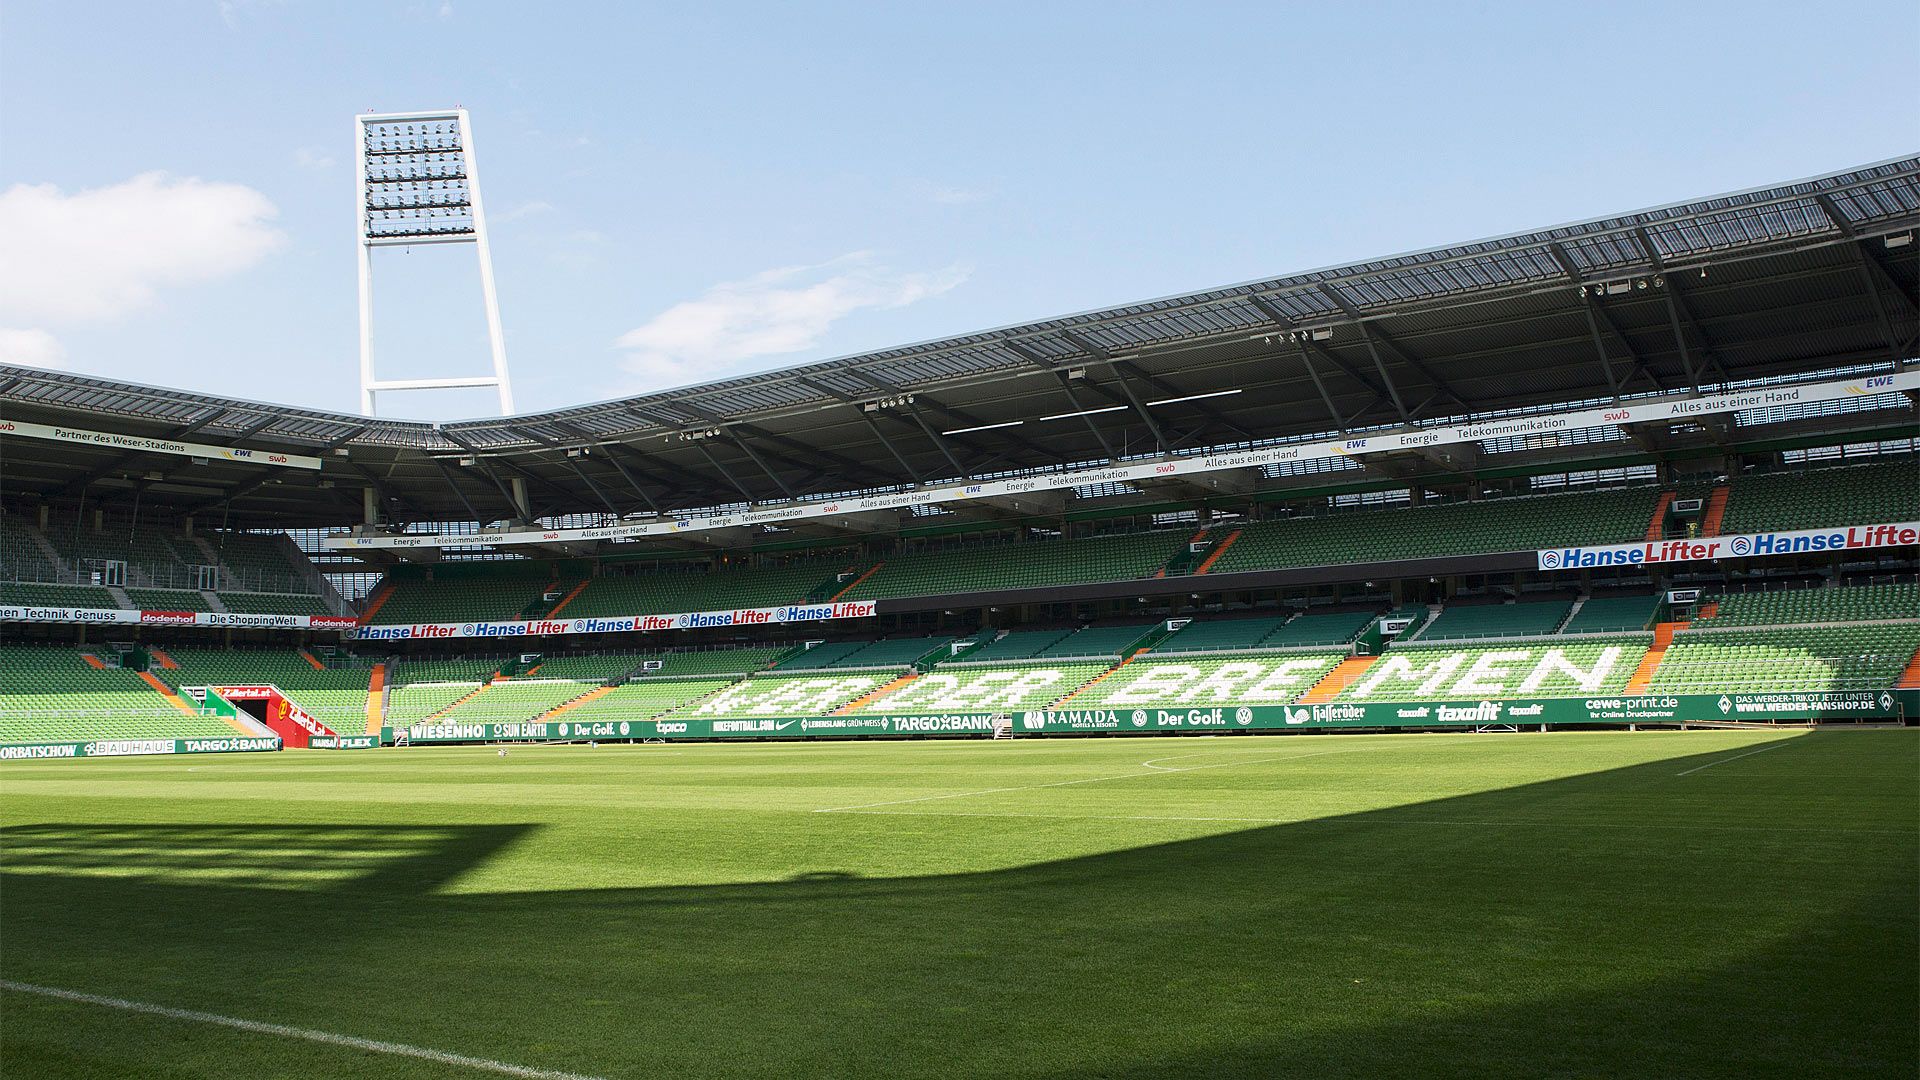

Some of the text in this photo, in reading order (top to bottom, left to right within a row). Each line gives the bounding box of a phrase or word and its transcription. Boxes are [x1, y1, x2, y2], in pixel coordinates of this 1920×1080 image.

[1866, 375, 1894, 389] EWE
[1670, 388, 1799, 414] Alles aus einer Hand
[1604, 409, 1630, 421] swb
[0, 422, 15, 431] wb
[1400, 418, 1566, 447] Energie Telekommunikation
[55, 429, 185, 452] Partner des Weser-Stadions
[1346, 439, 1367, 449] EWE
[269, 455, 287, 463] swb
[1205, 449, 1298, 468] Alles aus einer Hand
[1156, 463, 1175, 473] swb
[1006, 470, 1128, 492] Energie Telekommunikation
[860, 500, 878, 508] Alles
[892, 496, 910, 505] einer
[911, 493, 931, 502] Hand
[823, 504, 839, 513] swb
[709, 509, 803, 527] Energie Telekommunikation
[543, 532, 559, 540] swb
[581, 530, 599, 538] Alles
[612, 527, 629, 535] einer
[630, 526, 648, 534] Hand
[393, 535, 503, 546] Energie Telekommunikation
[1753, 526, 1920, 554] HanseLifte
[1562, 541, 1720, 567] HanseLifter
[24, 608, 69, 619] Technik
[74, 610, 116, 620] Genuss
[142, 614, 194, 623] dodenhof
[689, 610, 772, 627] HanseLifter
[787, 603, 874, 620] HanseLifter
[210, 615, 297, 626] Die ShoppingWelt
[311, 619, 357, 627] dodenhof
[585, 616, 674, 632] HanseLifter
[358, 624, 456, 638] HanseLifter
[476, 621, 568, 636] HanseLifter
[1585, 696, 1678, 710] cewe-print.de
[1757, 694, 1820, 703] WERDER-TRIKOT
[1821, 694, 1843, 702] JETZT
[1397, 707, 1430, 717] taxofit
[1435, 701, 1503, 721] taxofit
[1508, 704, 1544, 715] taxofit
[1736, 701, 1876, 712] WWW.WERDER-FANSHOP.DE
[1157, 709, 1226, 725] Der Golf.
[1626, 711, 1674, 719] Druckpartner
[502, 724, 520, 737] SUN
[521, 723, 547, 737] EARTH
[574, 723, 591, 736] Der
[592, 722, 616, 735] Golf.
[656, 721, 687, 734] tipico
[0, 745, 77, 759] ORBATSCHOW
[98, 742, 174, 753] BAUHAUS
